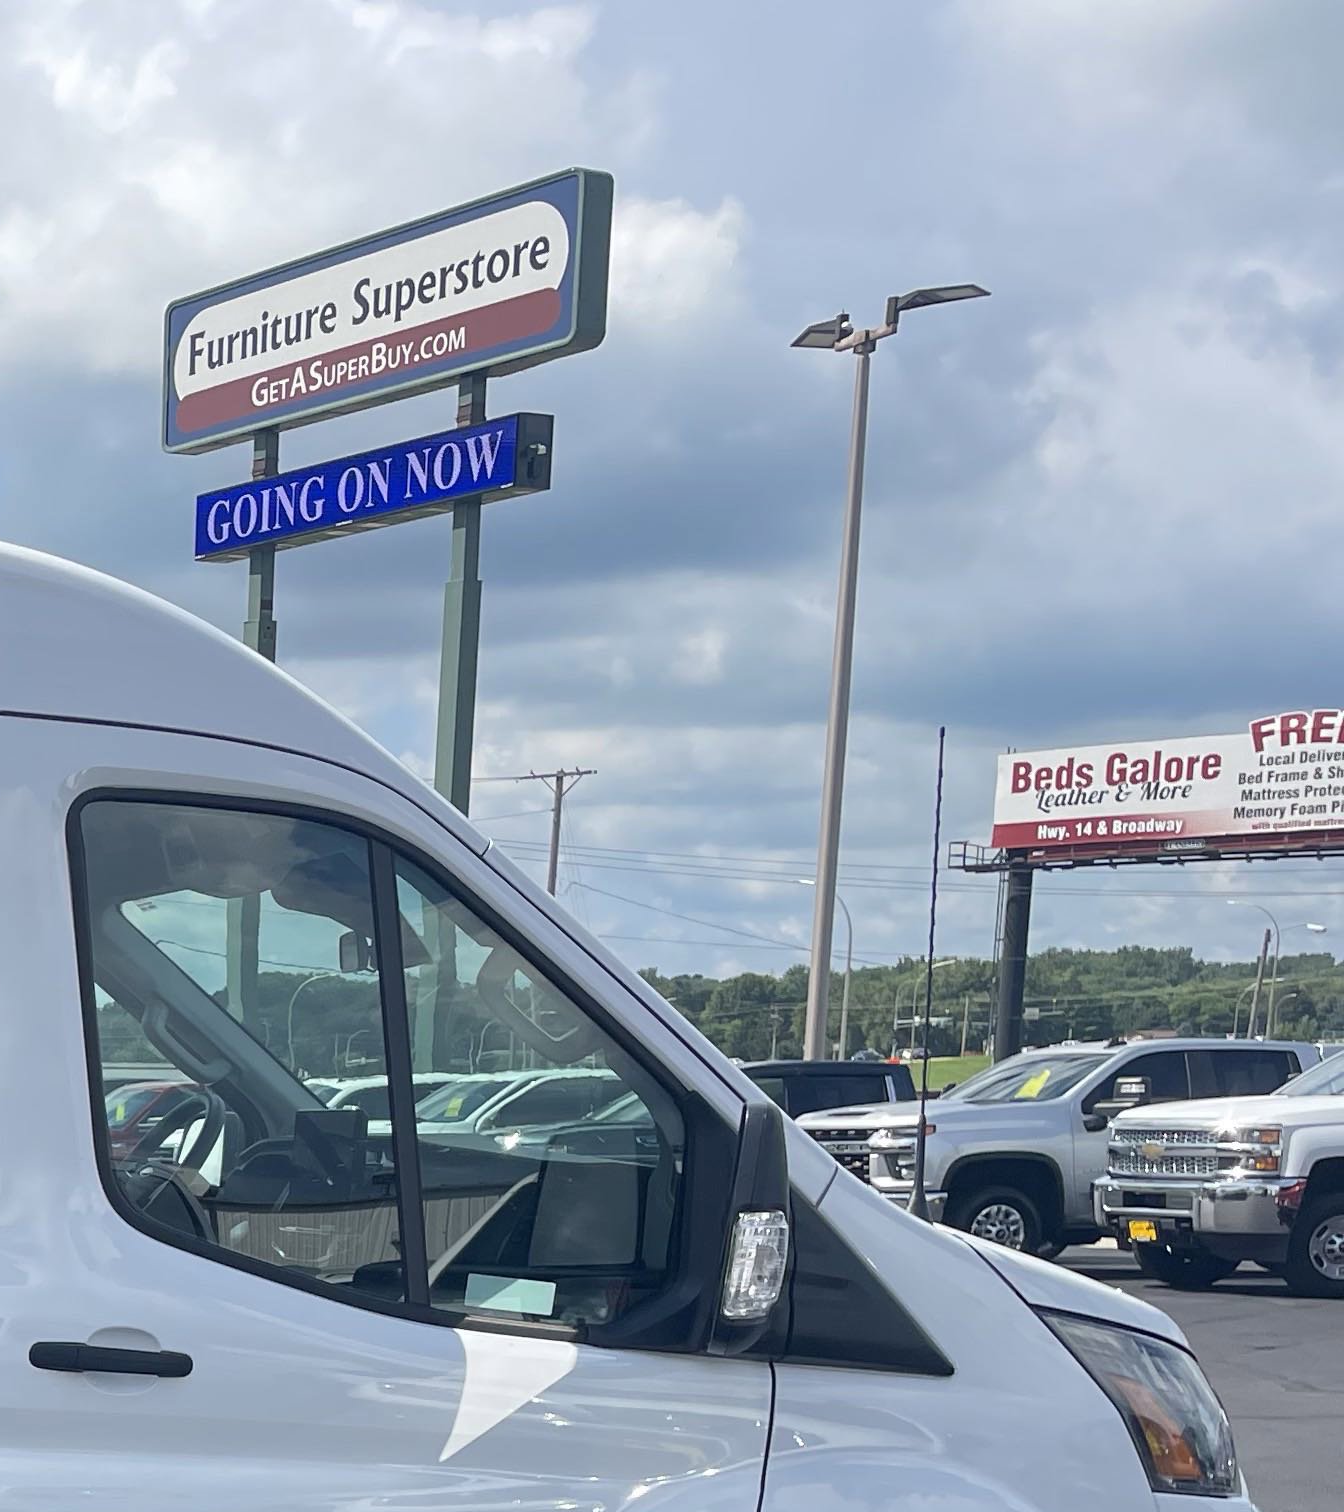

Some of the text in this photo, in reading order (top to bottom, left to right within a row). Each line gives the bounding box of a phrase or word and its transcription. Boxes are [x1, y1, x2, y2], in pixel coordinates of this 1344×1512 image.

[188, 235, 551, 376] Furniture Superstore
[207, 430, 504, 545] GOING ON NOW
[1259, 751, 1295, 767] Local
[1011, 750, 1222, 794] Beds Galore
[1238, 771, 1263, 785] Bed
[1267, 769, 1309, 783] Frame
[1313, 766, 1323, 780] &
[1035, 781, 1193, 814] Leather & More
[1241, 788, 1300, 802] Mattress
[1233, 805, 1287, 820] Memory
[1291, 802, 1327, 816] Foam
[1037, 817, 1184, 841] Hwy. 14 & Broadway
